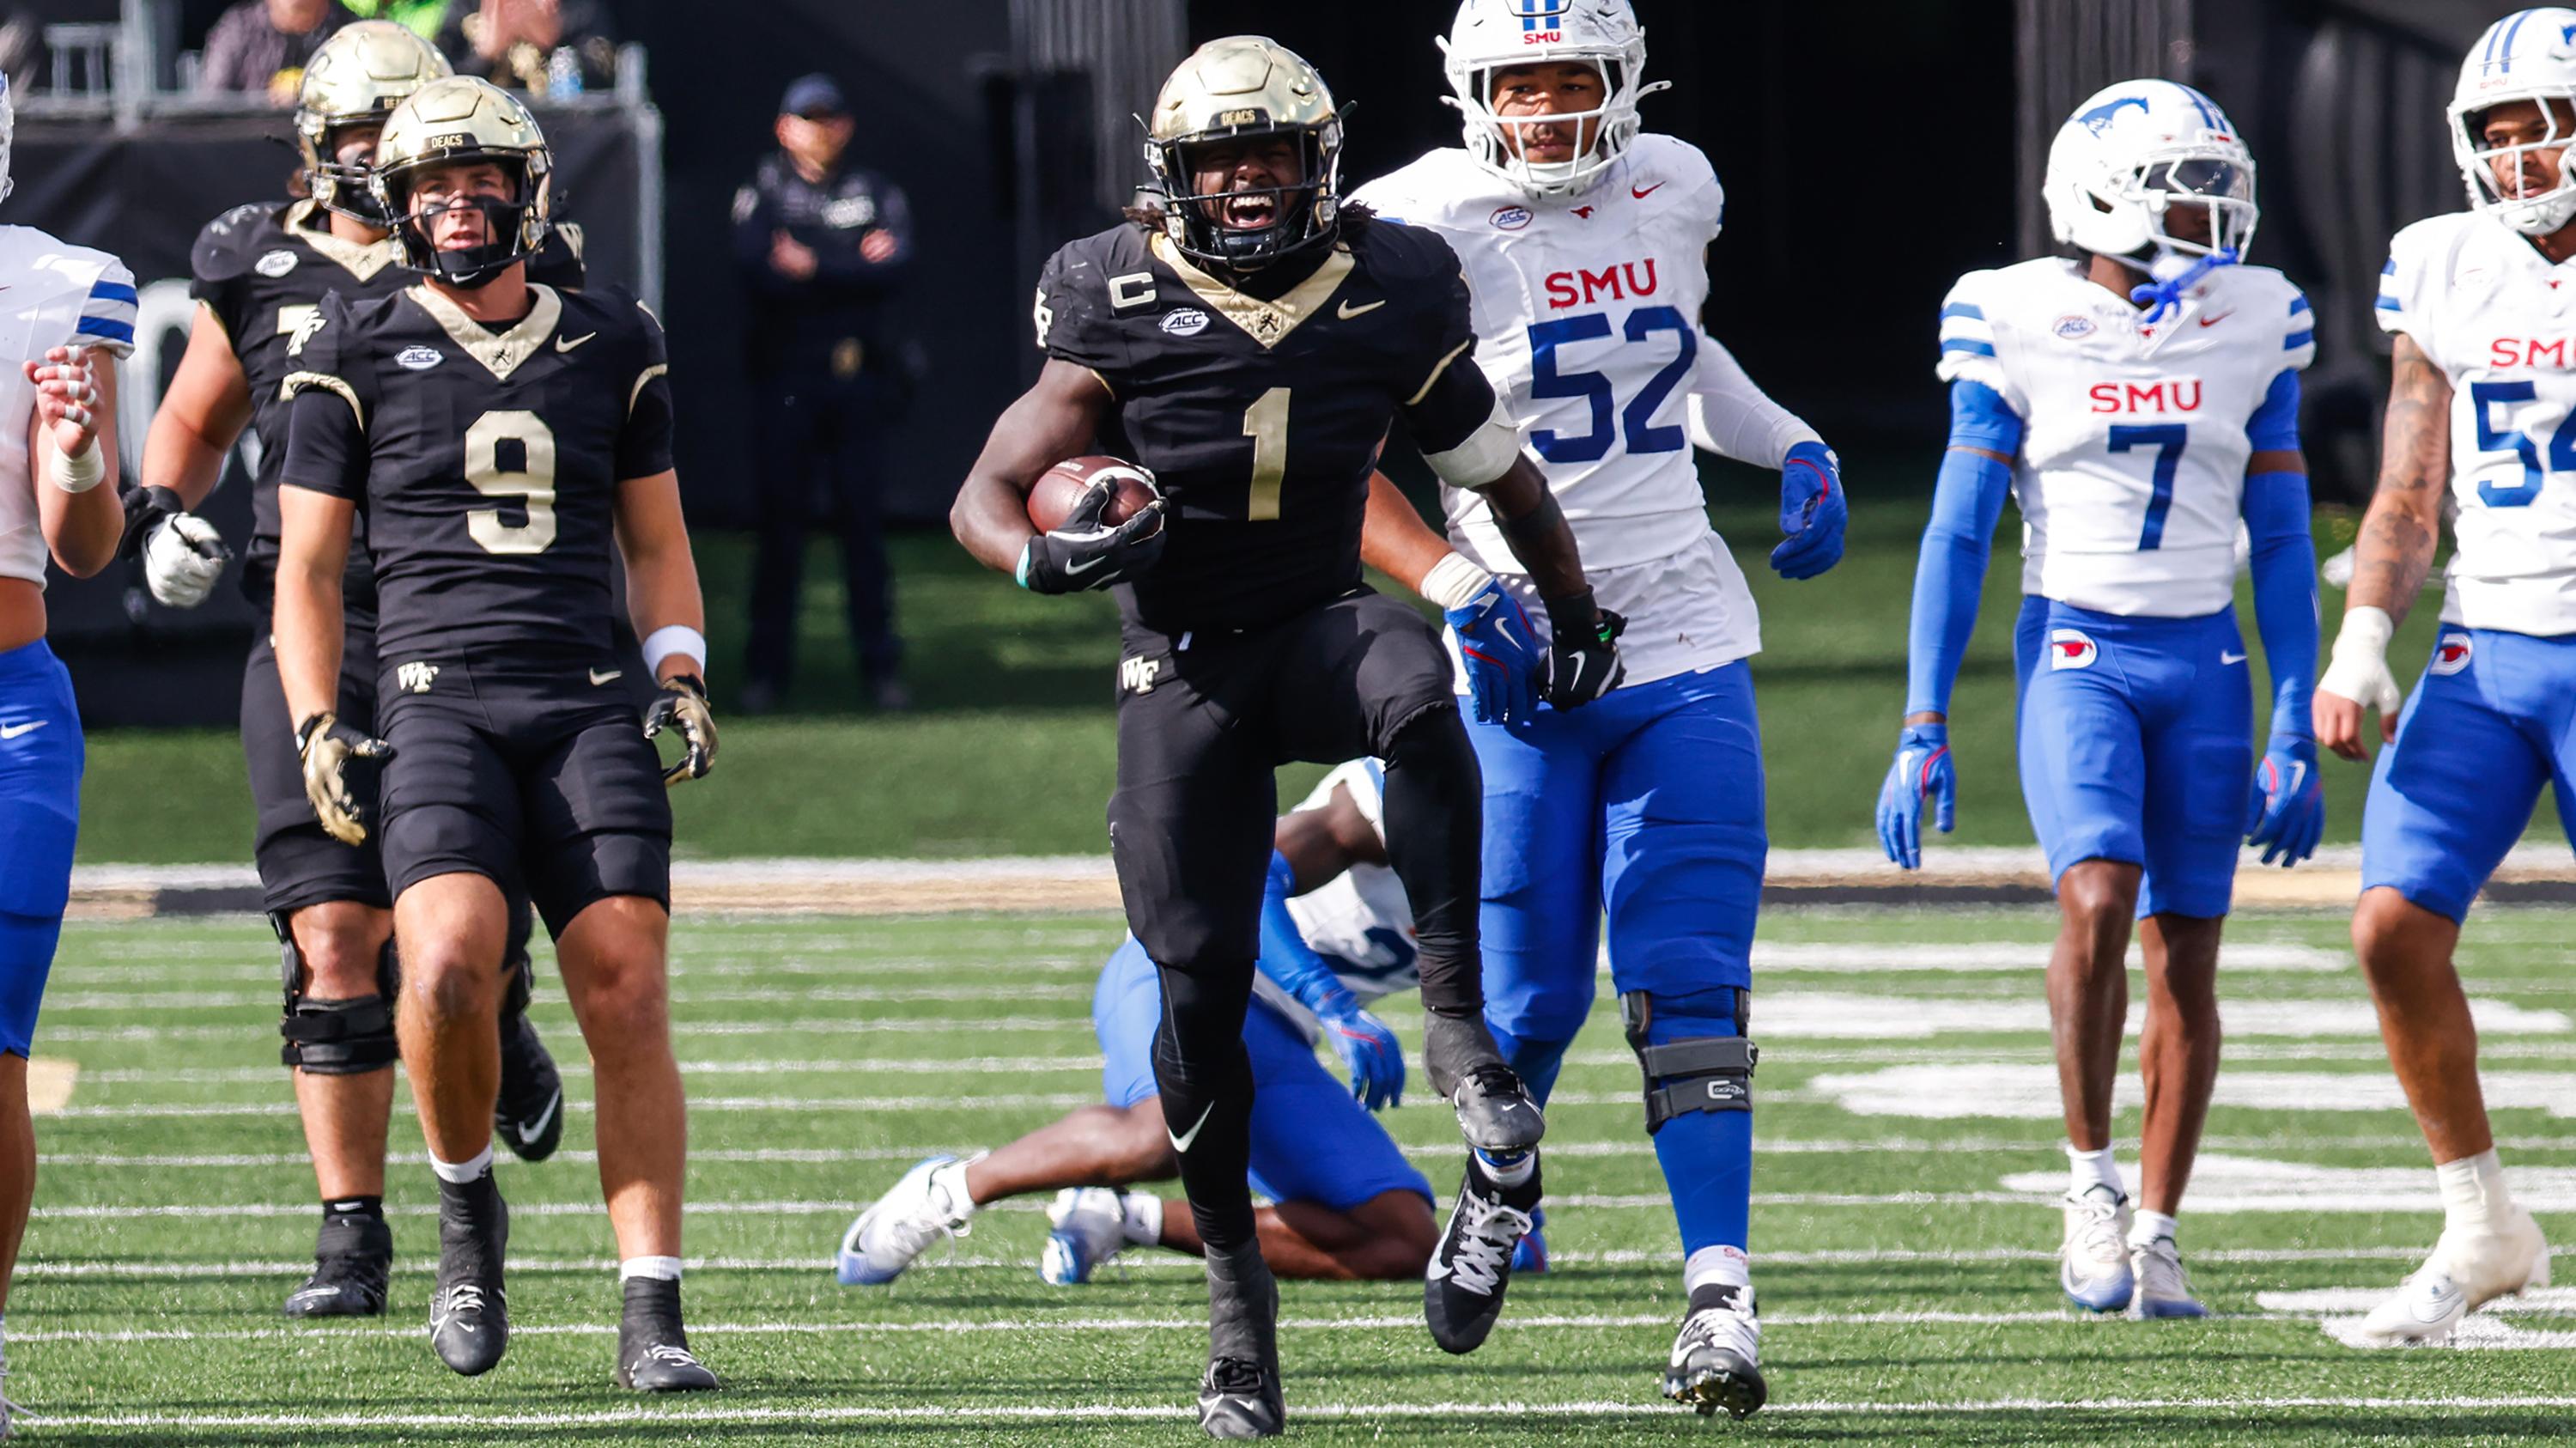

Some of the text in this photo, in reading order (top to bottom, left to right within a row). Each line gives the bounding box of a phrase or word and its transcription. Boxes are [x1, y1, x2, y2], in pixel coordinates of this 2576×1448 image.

[1523, 31, 1561, 45] SMU
[1220, 109, 1255, 126] DEACS
[431, 135, 464, 149] DEACS
[1498, 210, 1527, 222] ACC
[1109, 272, 1157, 308] C
[1545, 258, 1657, 309] SMU
[1169, 313, 1203, 326] ACC
[404, 351, 435, 361] ACC
[2490, 338, 2576, 368] SM
[1527, 305, 1698, 464] 52
[2089, 380, 2202, 413] SMU
[1242, 386, 1291, 521] 1
[465, 410, 557, 554] 9
[2107, 423, 2188, 551] 7
[398, 661, 439, 693] WF
[1121, 654, 1159, 695] WF
